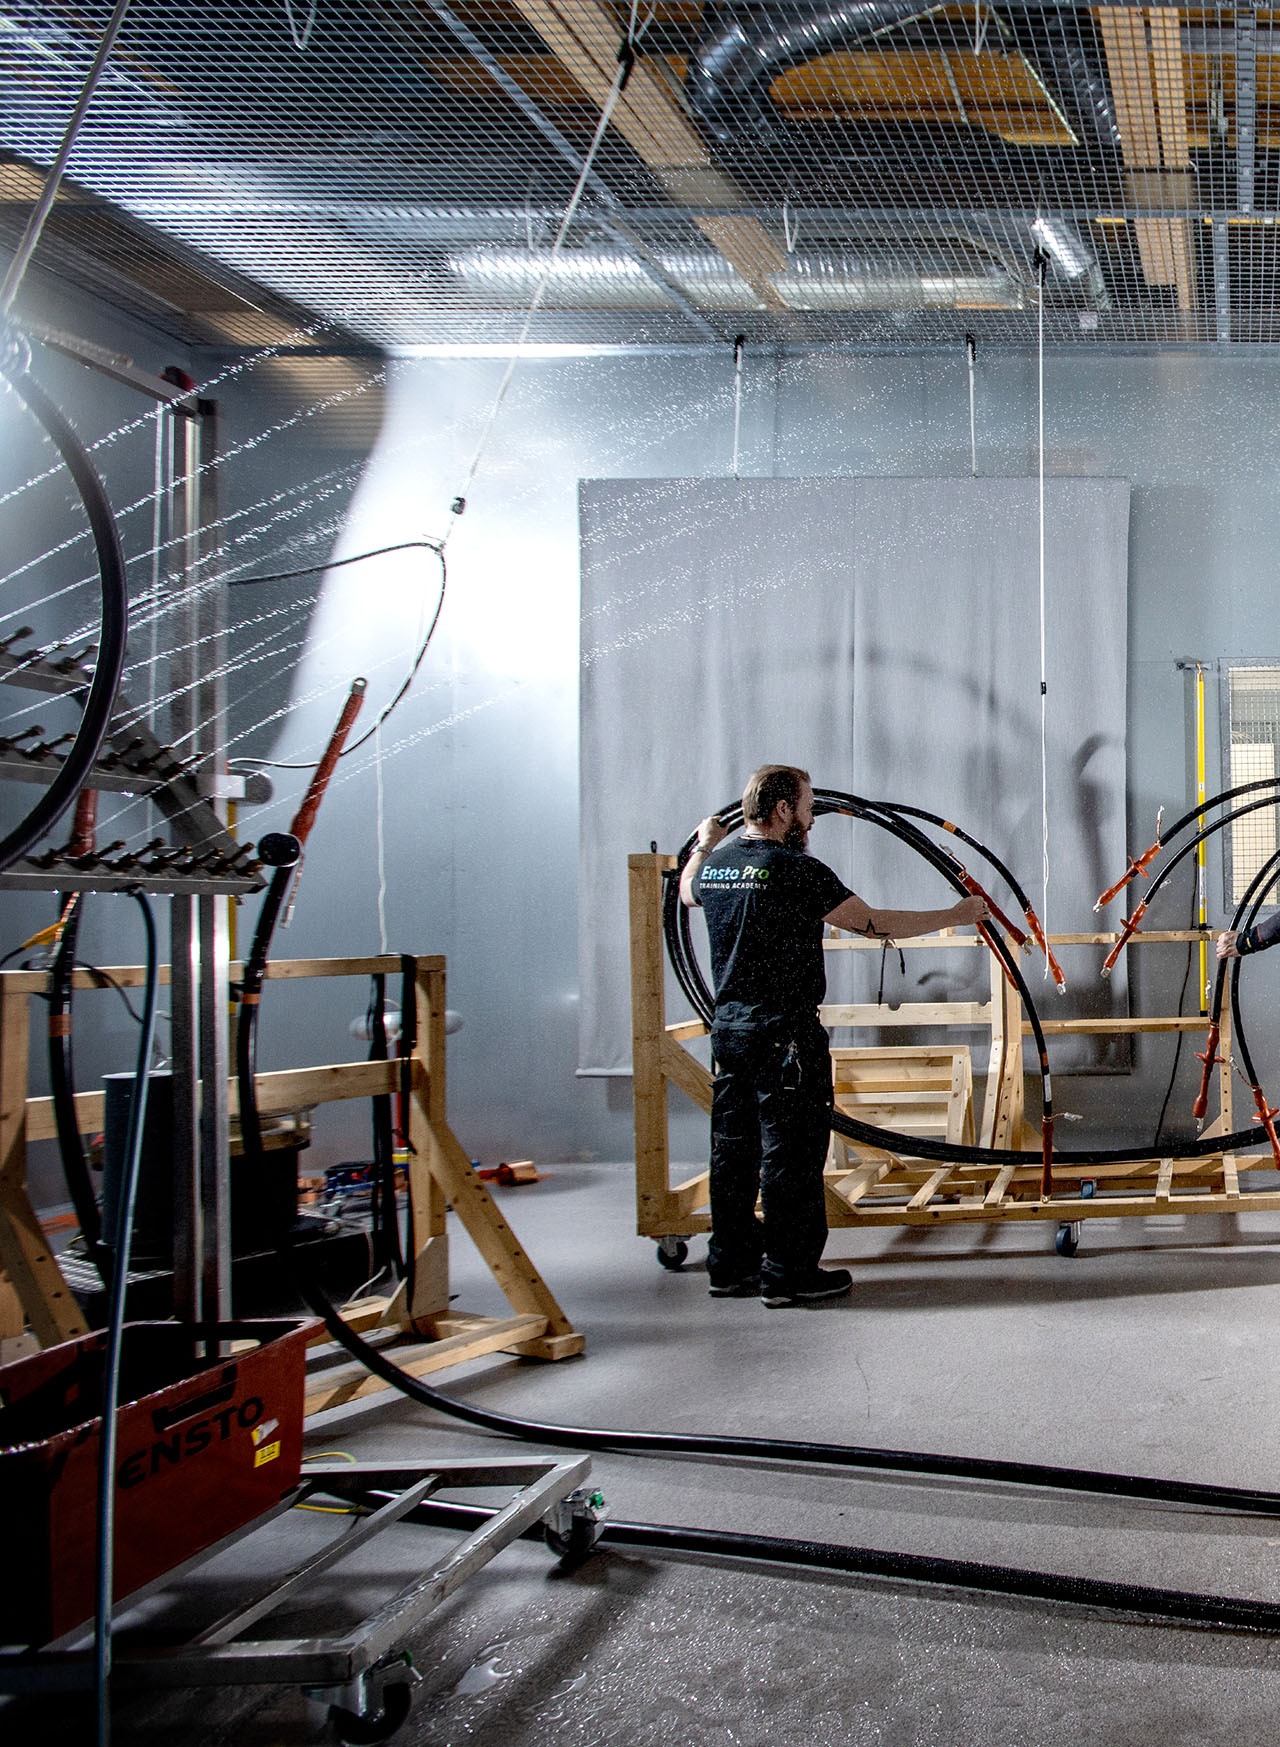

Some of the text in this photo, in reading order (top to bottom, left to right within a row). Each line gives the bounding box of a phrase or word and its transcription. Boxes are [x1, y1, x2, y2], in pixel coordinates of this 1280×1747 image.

[700, 865, 770, 881] Ensto Pro
[731, 882, 768, 890] ACADEMY
[117, 1396, 264, 1489] ENSTO
